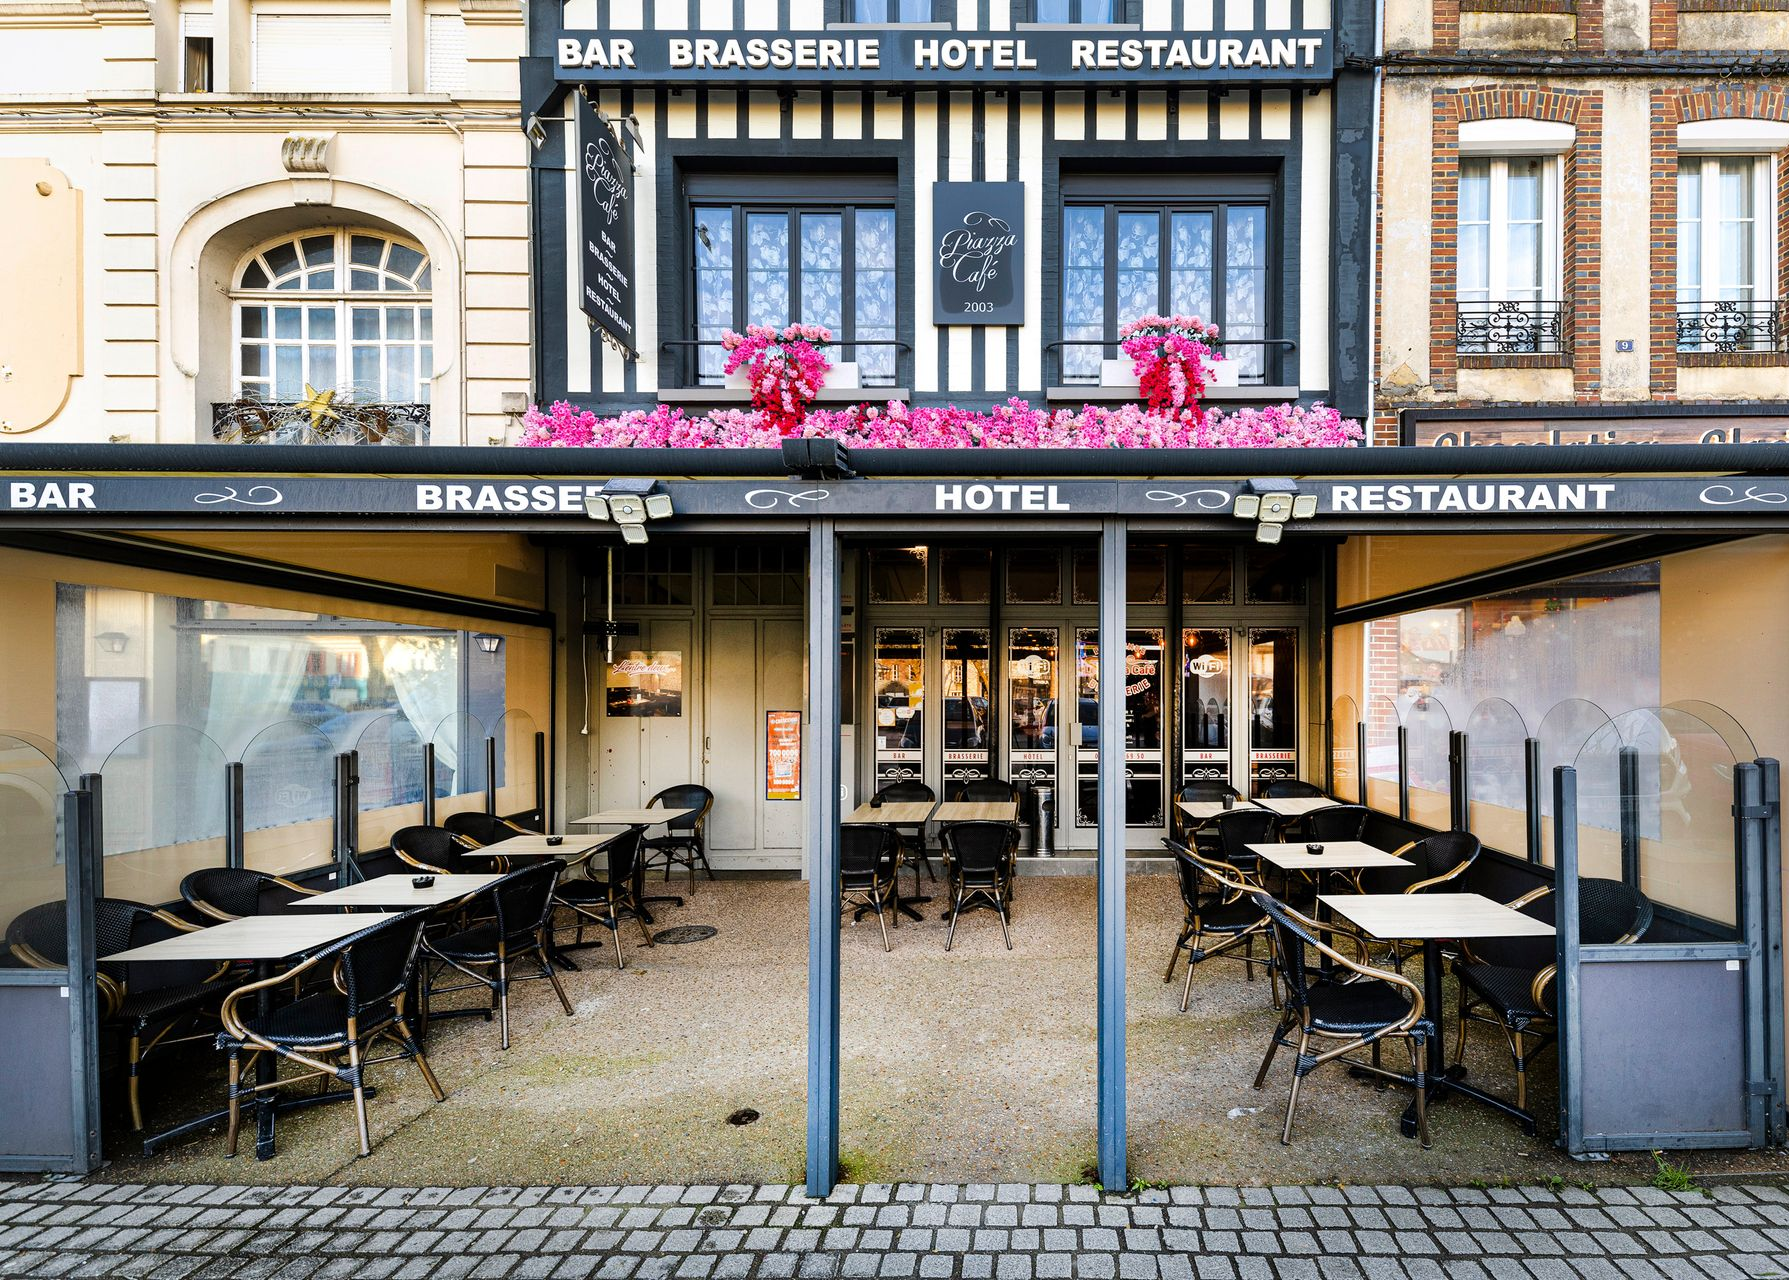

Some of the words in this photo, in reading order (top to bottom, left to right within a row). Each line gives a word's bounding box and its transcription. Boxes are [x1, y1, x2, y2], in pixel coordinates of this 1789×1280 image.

[558, 38, 636, 68] BAR
[669, 38, 880, 69] BRASSERIE
[914, 39, 1037, 69] HOTEL
[1071, 38, 1322, 69] RESTAURANT
[585, 137, 628, 200] Piazza
[593, 178, 619, 225] Café
[601, 230, 617, 254] BAR
[939, 212, 1018, 262] Piazza
[588, 240, 628, 288] BRASSERIE
[948, 252, 998, 292] Café
[597, 272, 621, 303] HOTEL
[586, 285, 632, 335] RESTAURANT
[964, 302, 995, 313] 2003
[10, 483, 97, 508] BAR
[935, 485, 1070, 511] HOTEL
[1332, 485, 1616, 510] RESTAURANT
[1255, 752, 1291, 760] BRASSERIE
